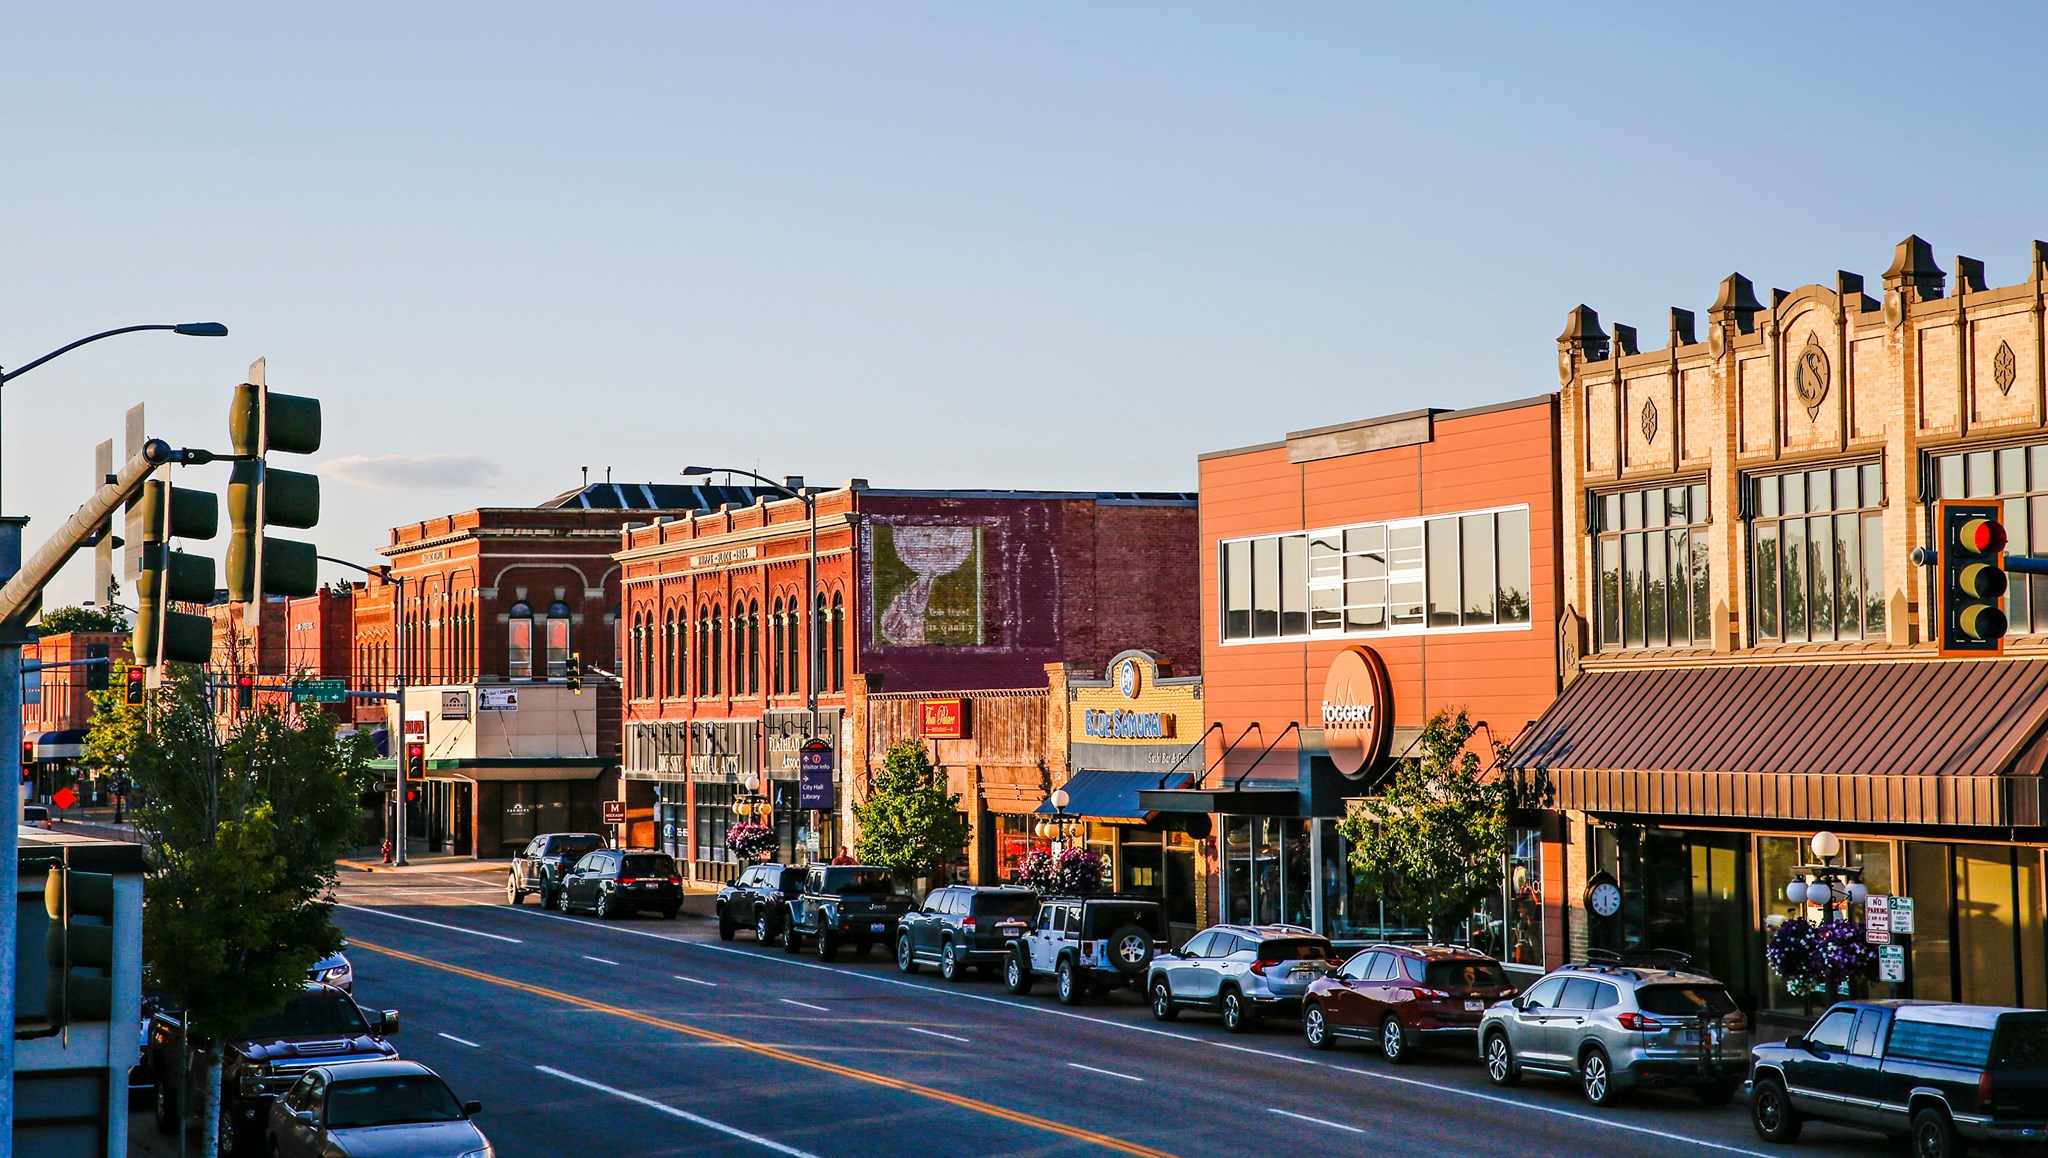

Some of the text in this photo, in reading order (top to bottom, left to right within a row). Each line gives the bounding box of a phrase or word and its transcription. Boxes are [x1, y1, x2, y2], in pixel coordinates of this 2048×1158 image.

[925, 705, 955, 725] Thai Palace
[1321, 705, 1374, 722] TOGGERY
[1085, 708, 1163, 738] BLUE SAMURAI
[768, 736, 800, 752] FLATHEAD
[658, 755, 739, 774] BIG SKY MARTIAL ARTS
[1148, 752, 1161, 764] Sushi
[1162, 753, 1170, 764] Bar
[610, 803, 620, 813] M
[869, 903, 887, 911] Jeep
